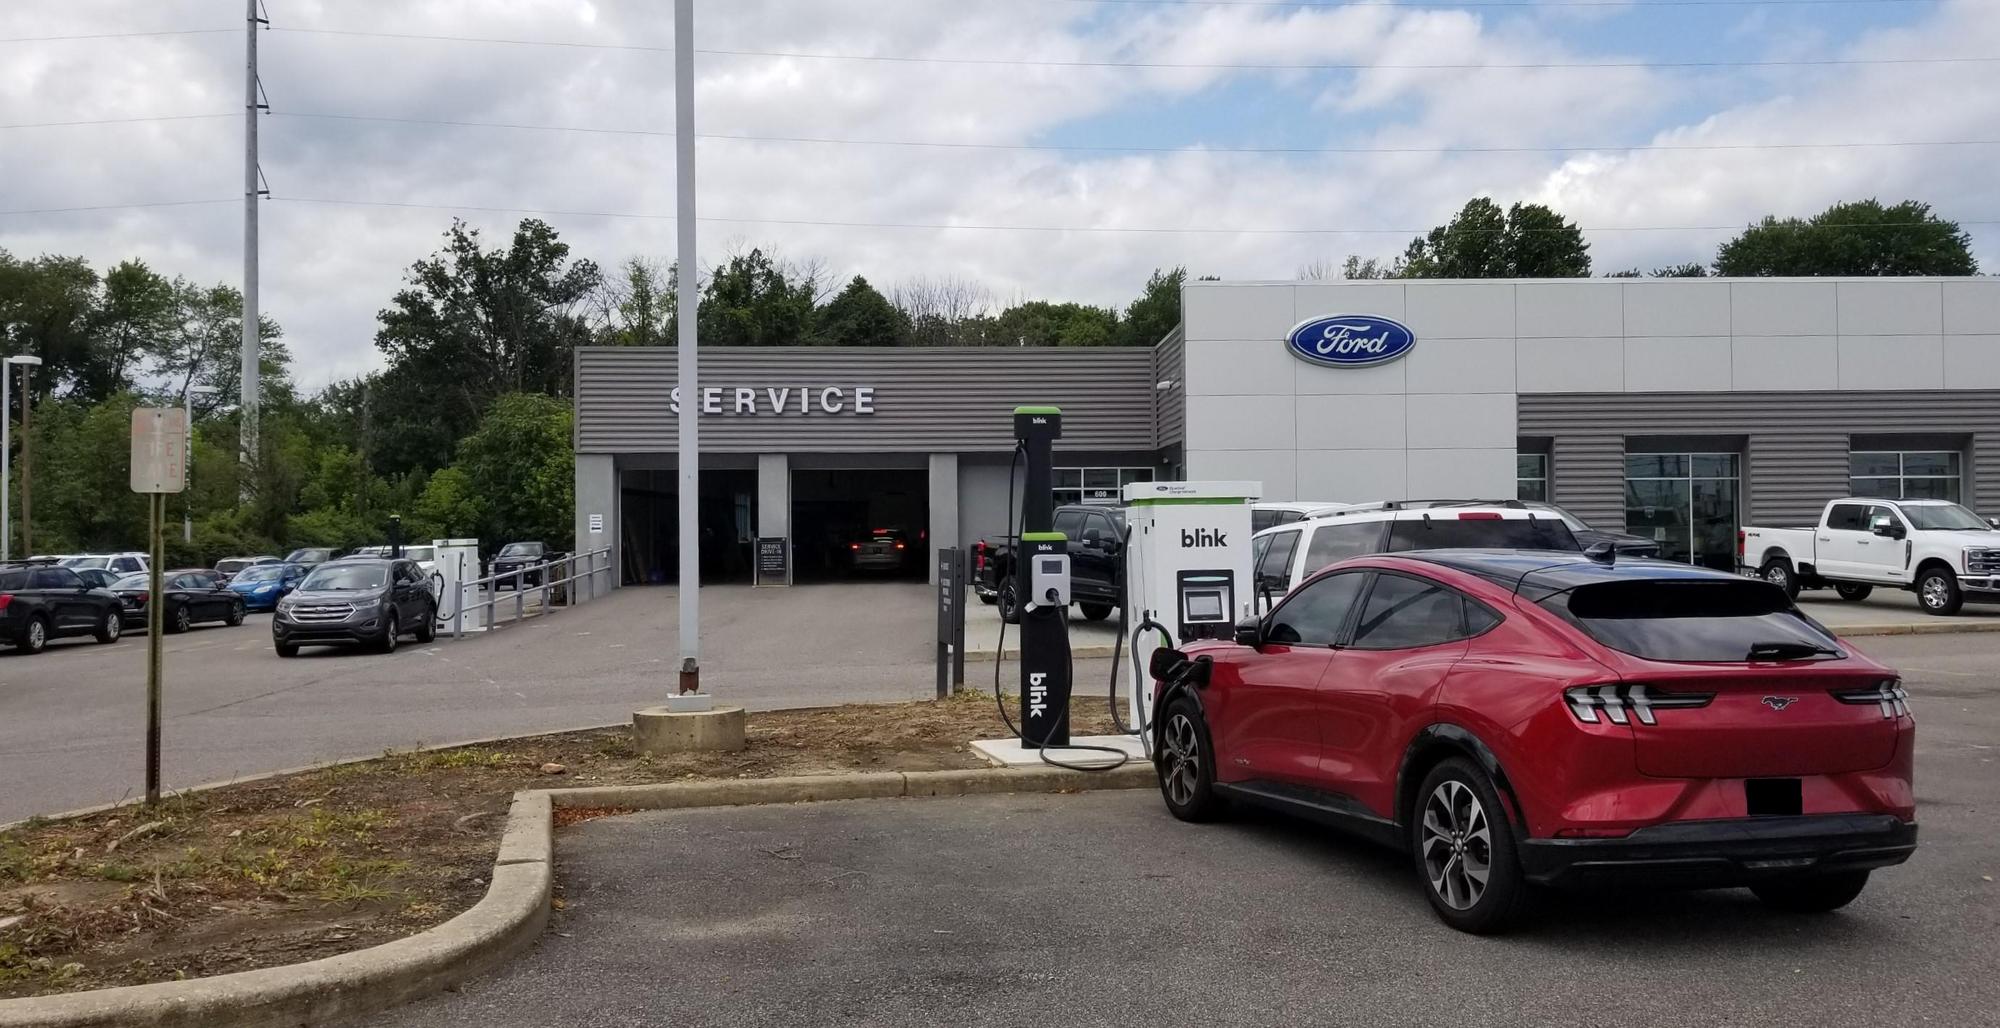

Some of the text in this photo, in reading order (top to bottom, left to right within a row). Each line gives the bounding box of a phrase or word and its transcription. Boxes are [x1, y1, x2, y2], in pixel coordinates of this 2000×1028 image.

[1316, 324, 1389, 354] Ford
[1181, 528, 1228, 548] blink
[1030, 672, 1048, 719] blink
